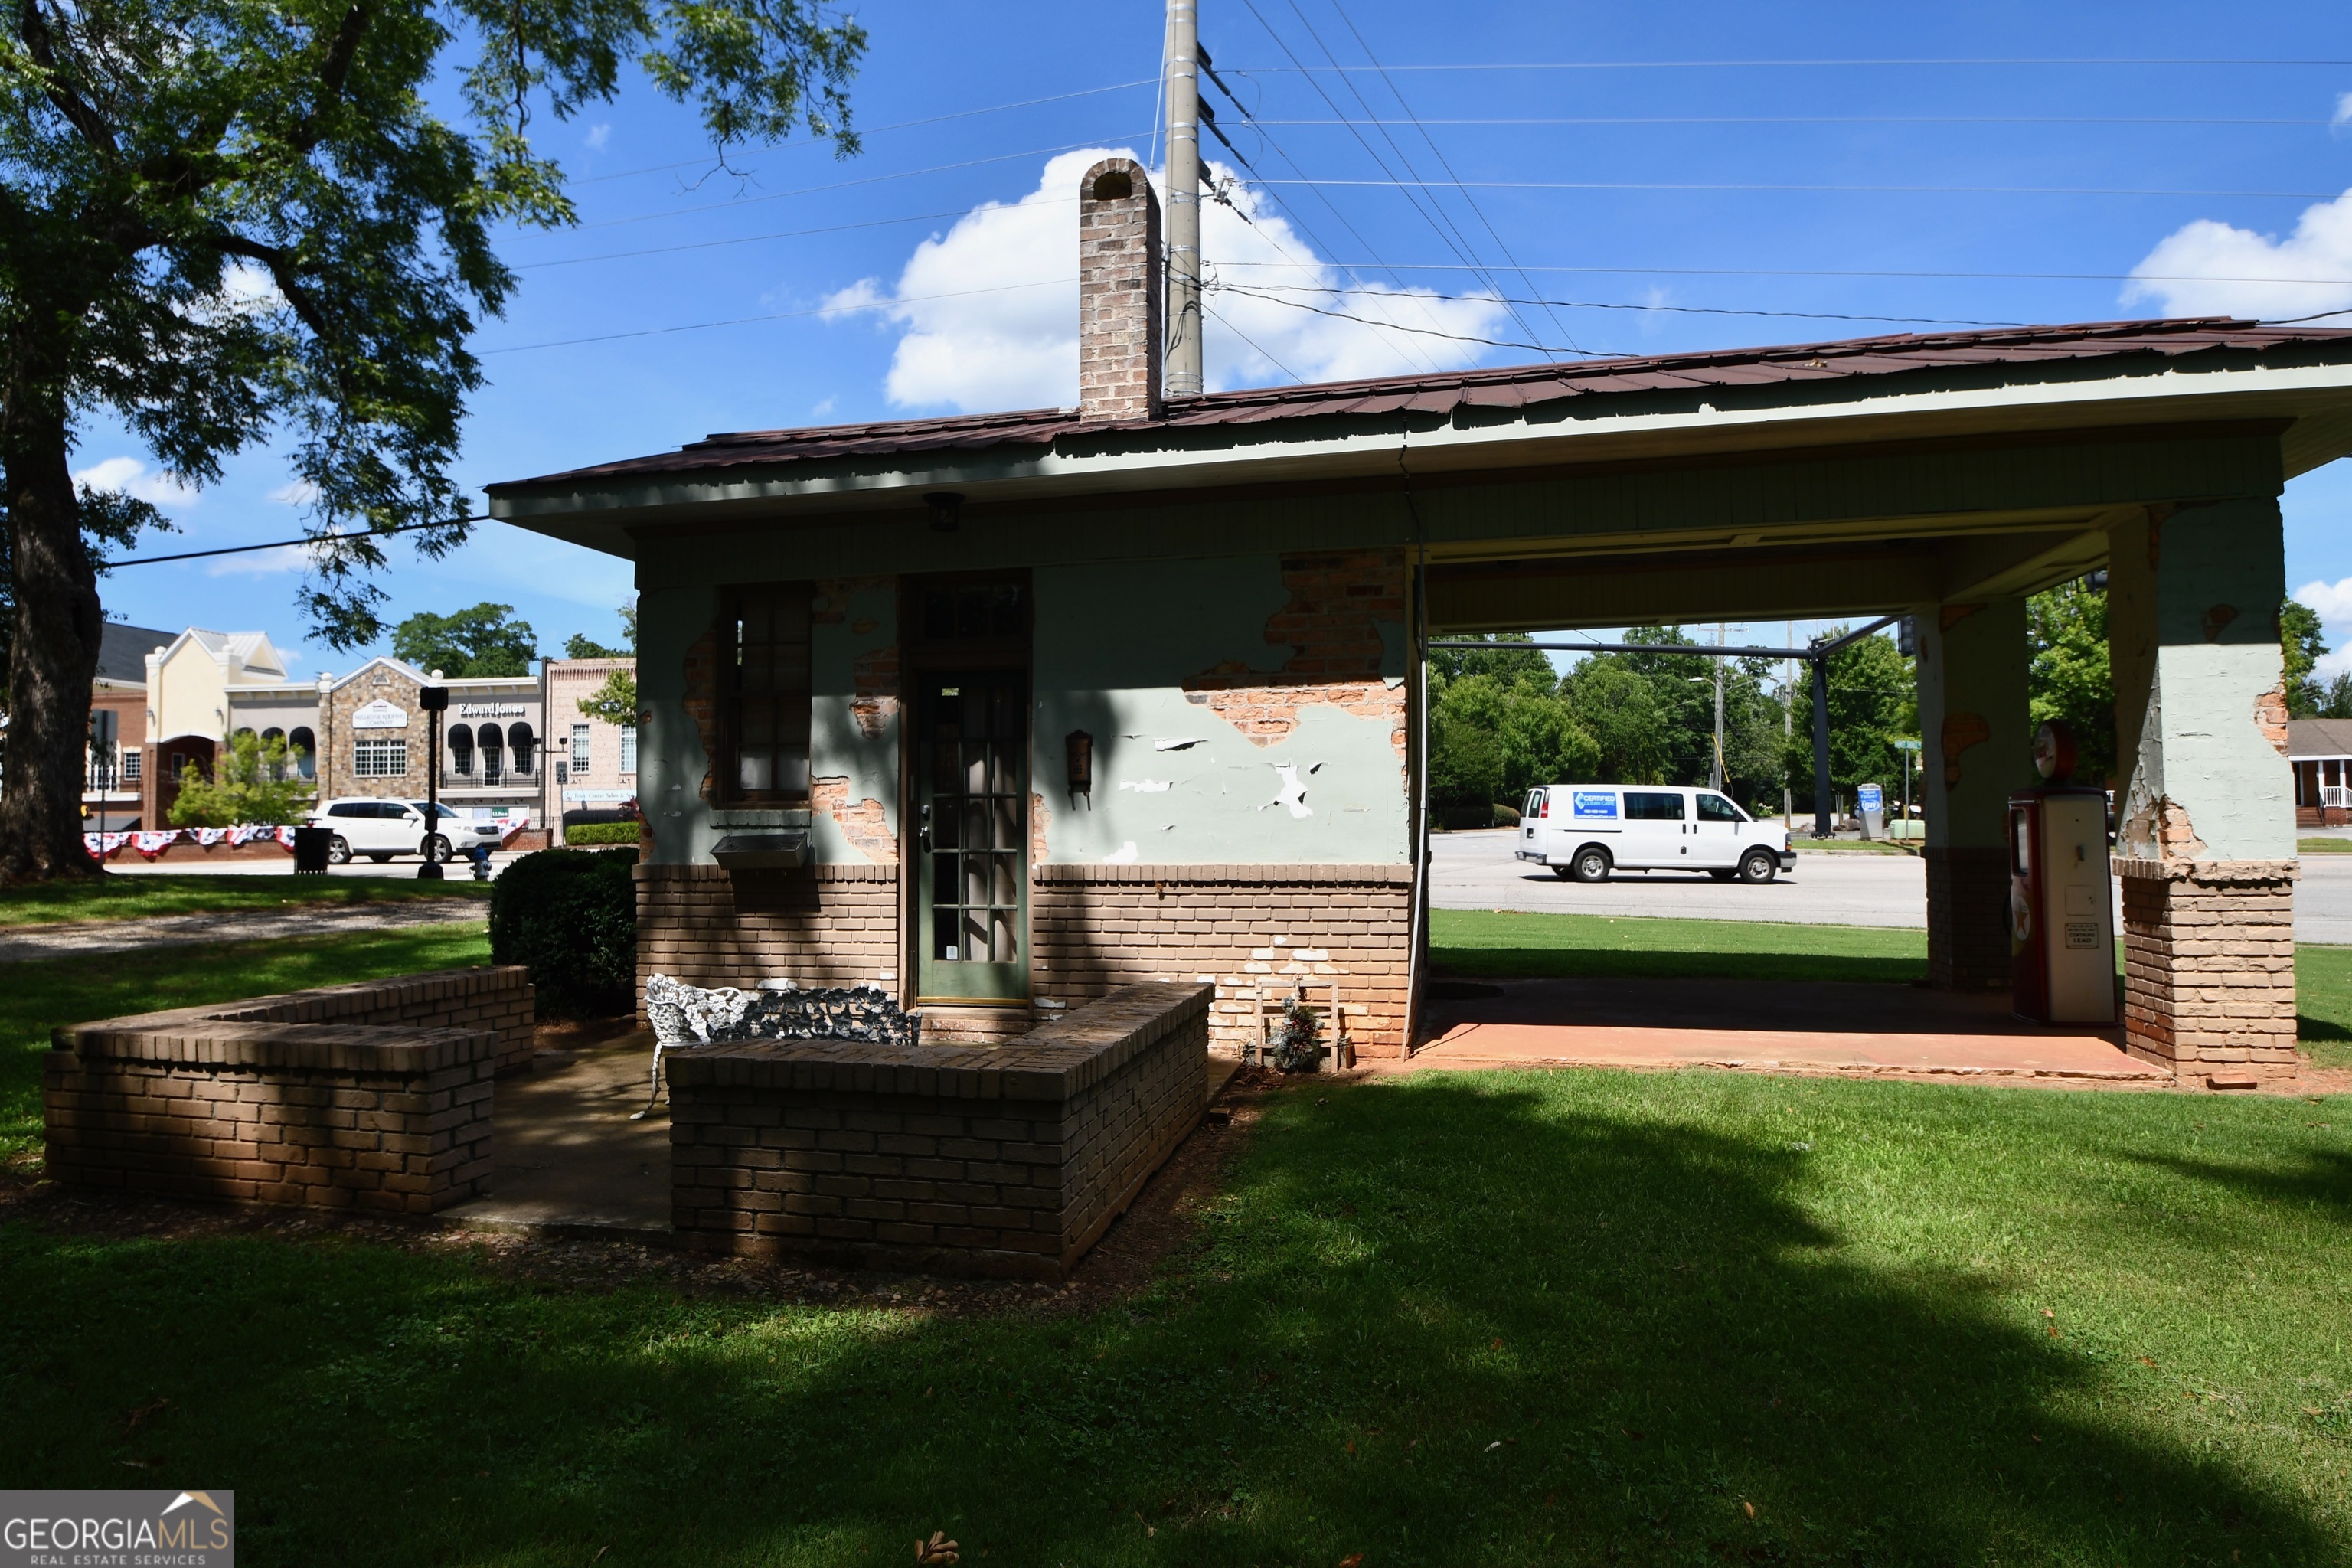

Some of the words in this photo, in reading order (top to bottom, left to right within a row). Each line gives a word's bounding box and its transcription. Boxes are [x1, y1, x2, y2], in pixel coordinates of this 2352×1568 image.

[459, 703, 494, 714] Edward
[495, 702, 524, 715] Jones
[557, 773, 567, 782] 25
